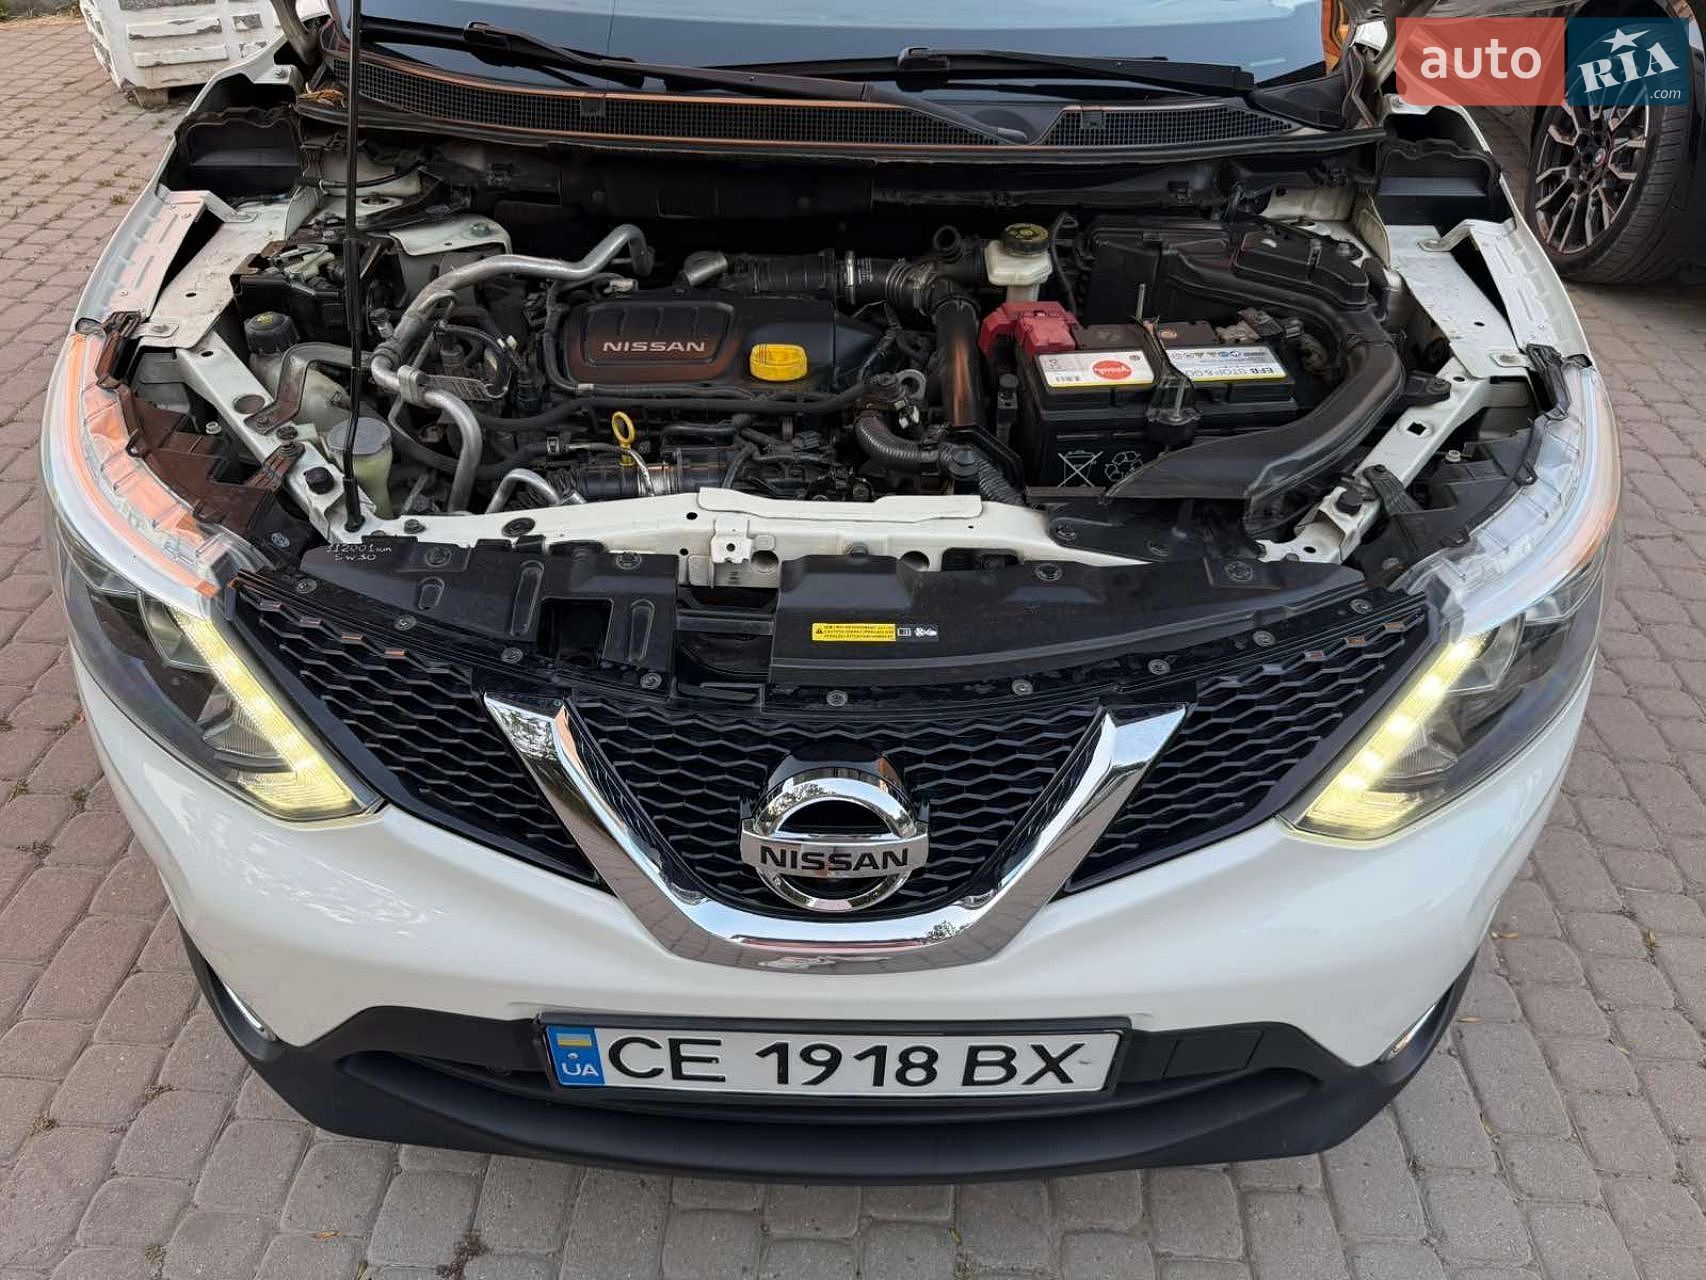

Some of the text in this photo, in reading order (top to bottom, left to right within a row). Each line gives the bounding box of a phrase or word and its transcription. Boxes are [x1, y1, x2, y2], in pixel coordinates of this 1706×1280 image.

[602, 341, 705, 352] NISSAN
[760, 845, 908, 872] NISSAN
[561, 1062, 599, 1077] UA
[608, 1036, 1086, 1087] CE 1918 BX
